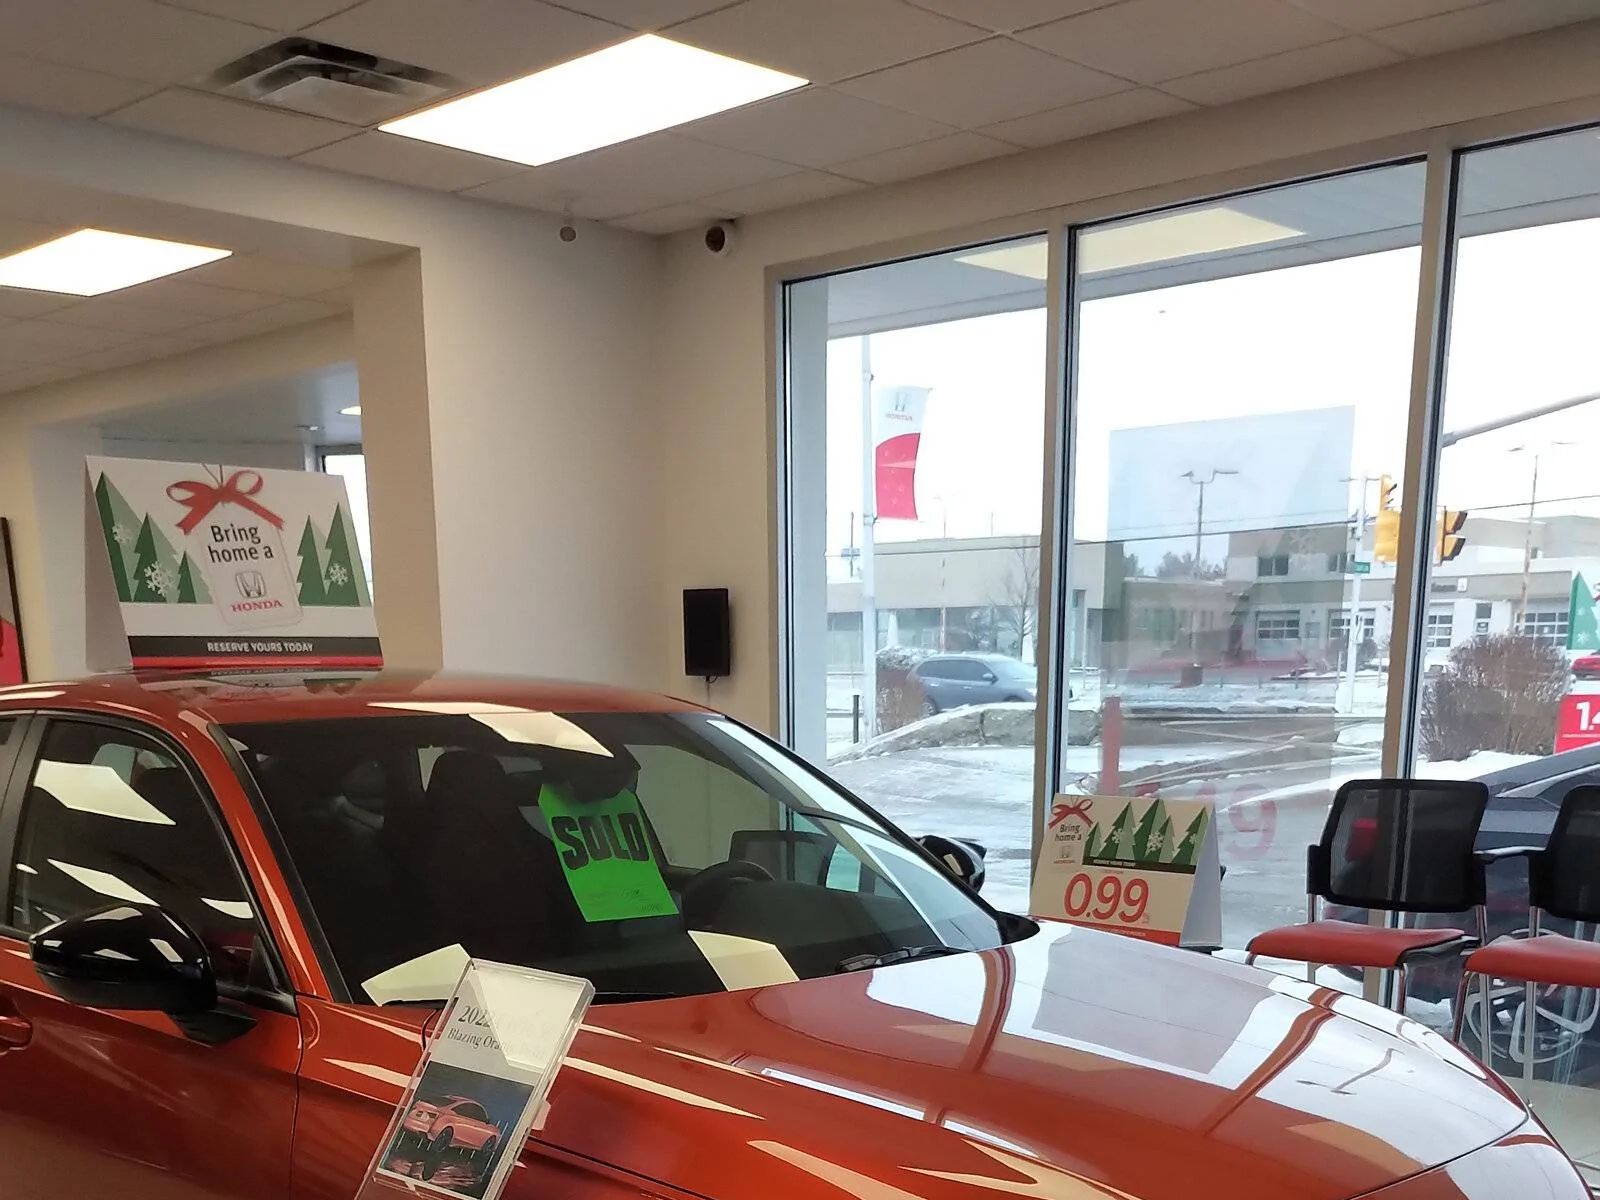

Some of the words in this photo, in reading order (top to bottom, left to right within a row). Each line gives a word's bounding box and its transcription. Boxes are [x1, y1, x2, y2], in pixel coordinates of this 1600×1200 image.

[210, 523, 261, 545] Bring
[207, 545, 260, 563] home
[263, 545, 274, 559] a
[231, 600, 283, 612] HONDA
[207, 642, 250, 652] RESERVE
[250, 642, 282, 652] YOURS
[284, 642, 313, 652] TODAY
[551, 812, 650, 870] SOLD
[1064, 873, 1149, 923] 0.99
[447, 1028, 482, 1049] Blazing
